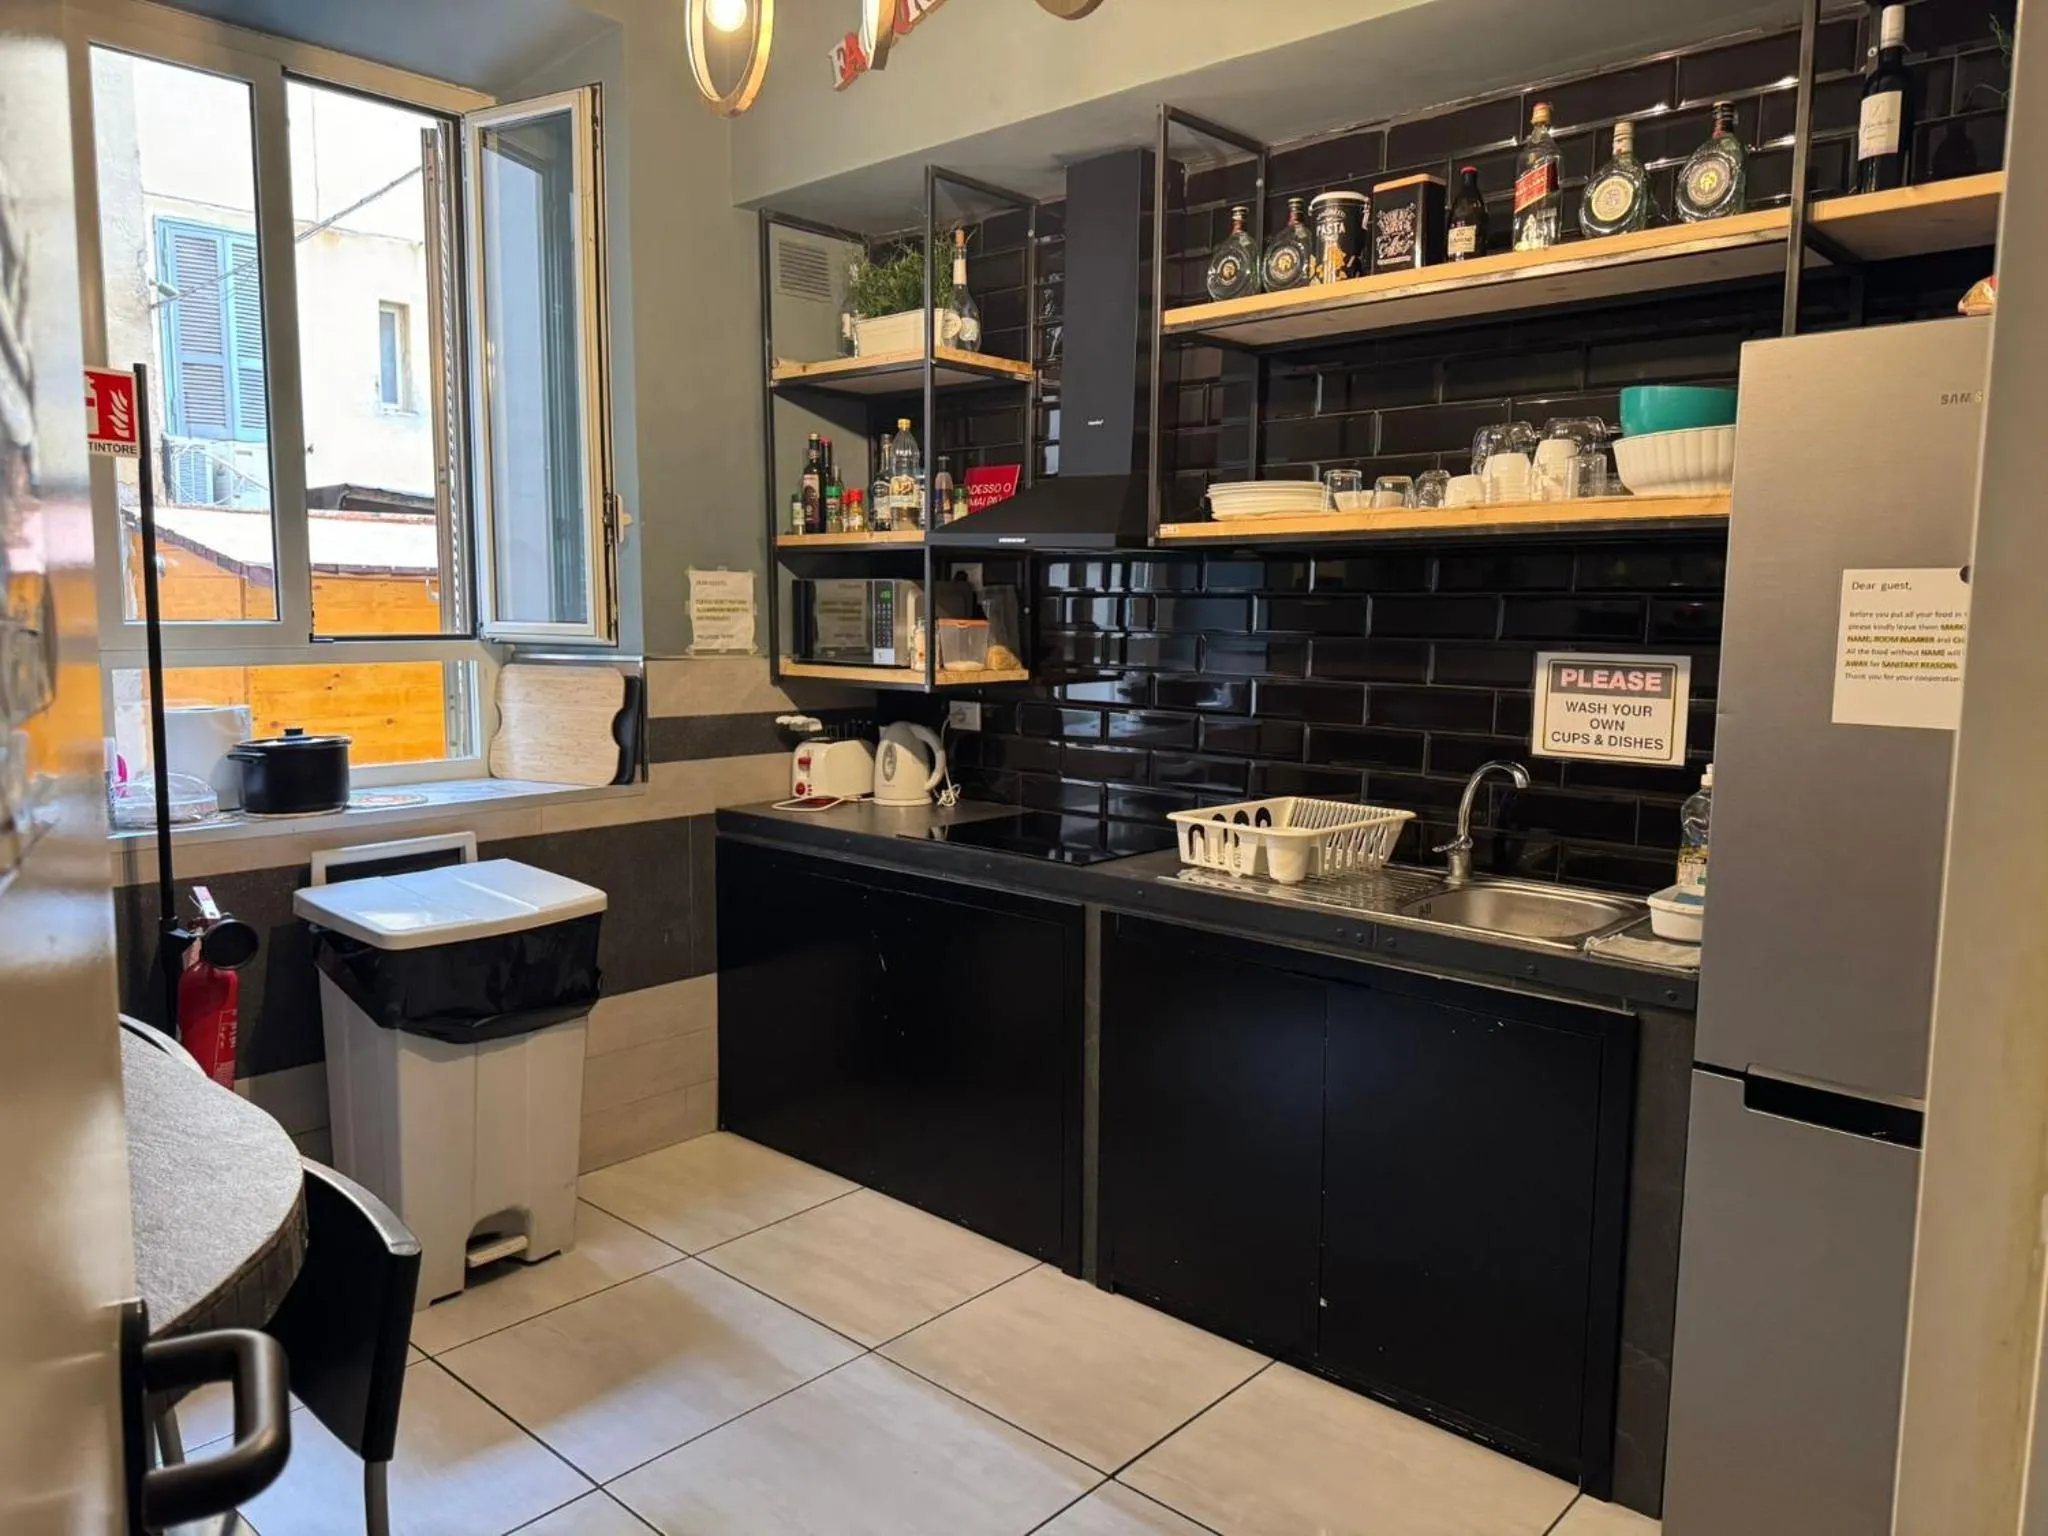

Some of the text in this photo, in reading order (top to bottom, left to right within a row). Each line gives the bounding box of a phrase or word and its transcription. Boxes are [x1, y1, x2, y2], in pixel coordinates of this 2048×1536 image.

[1316, 222, 1346, 237] PASTA
[88, 441, 137, 455] TINTORE
[1003, 483, 1012, 492] O
[1852, 581, 1912, 592] Dear guest,
[1882, 660, 1919, 668] SANITARY
[1560, 668, 1663, 693] PLEASE
[1566, 700, 1653, 717] WASH YOUR
[1589, 718, 1625, 731] OWN
[1551, 731, 1664, 750] CUPS & DISHES
